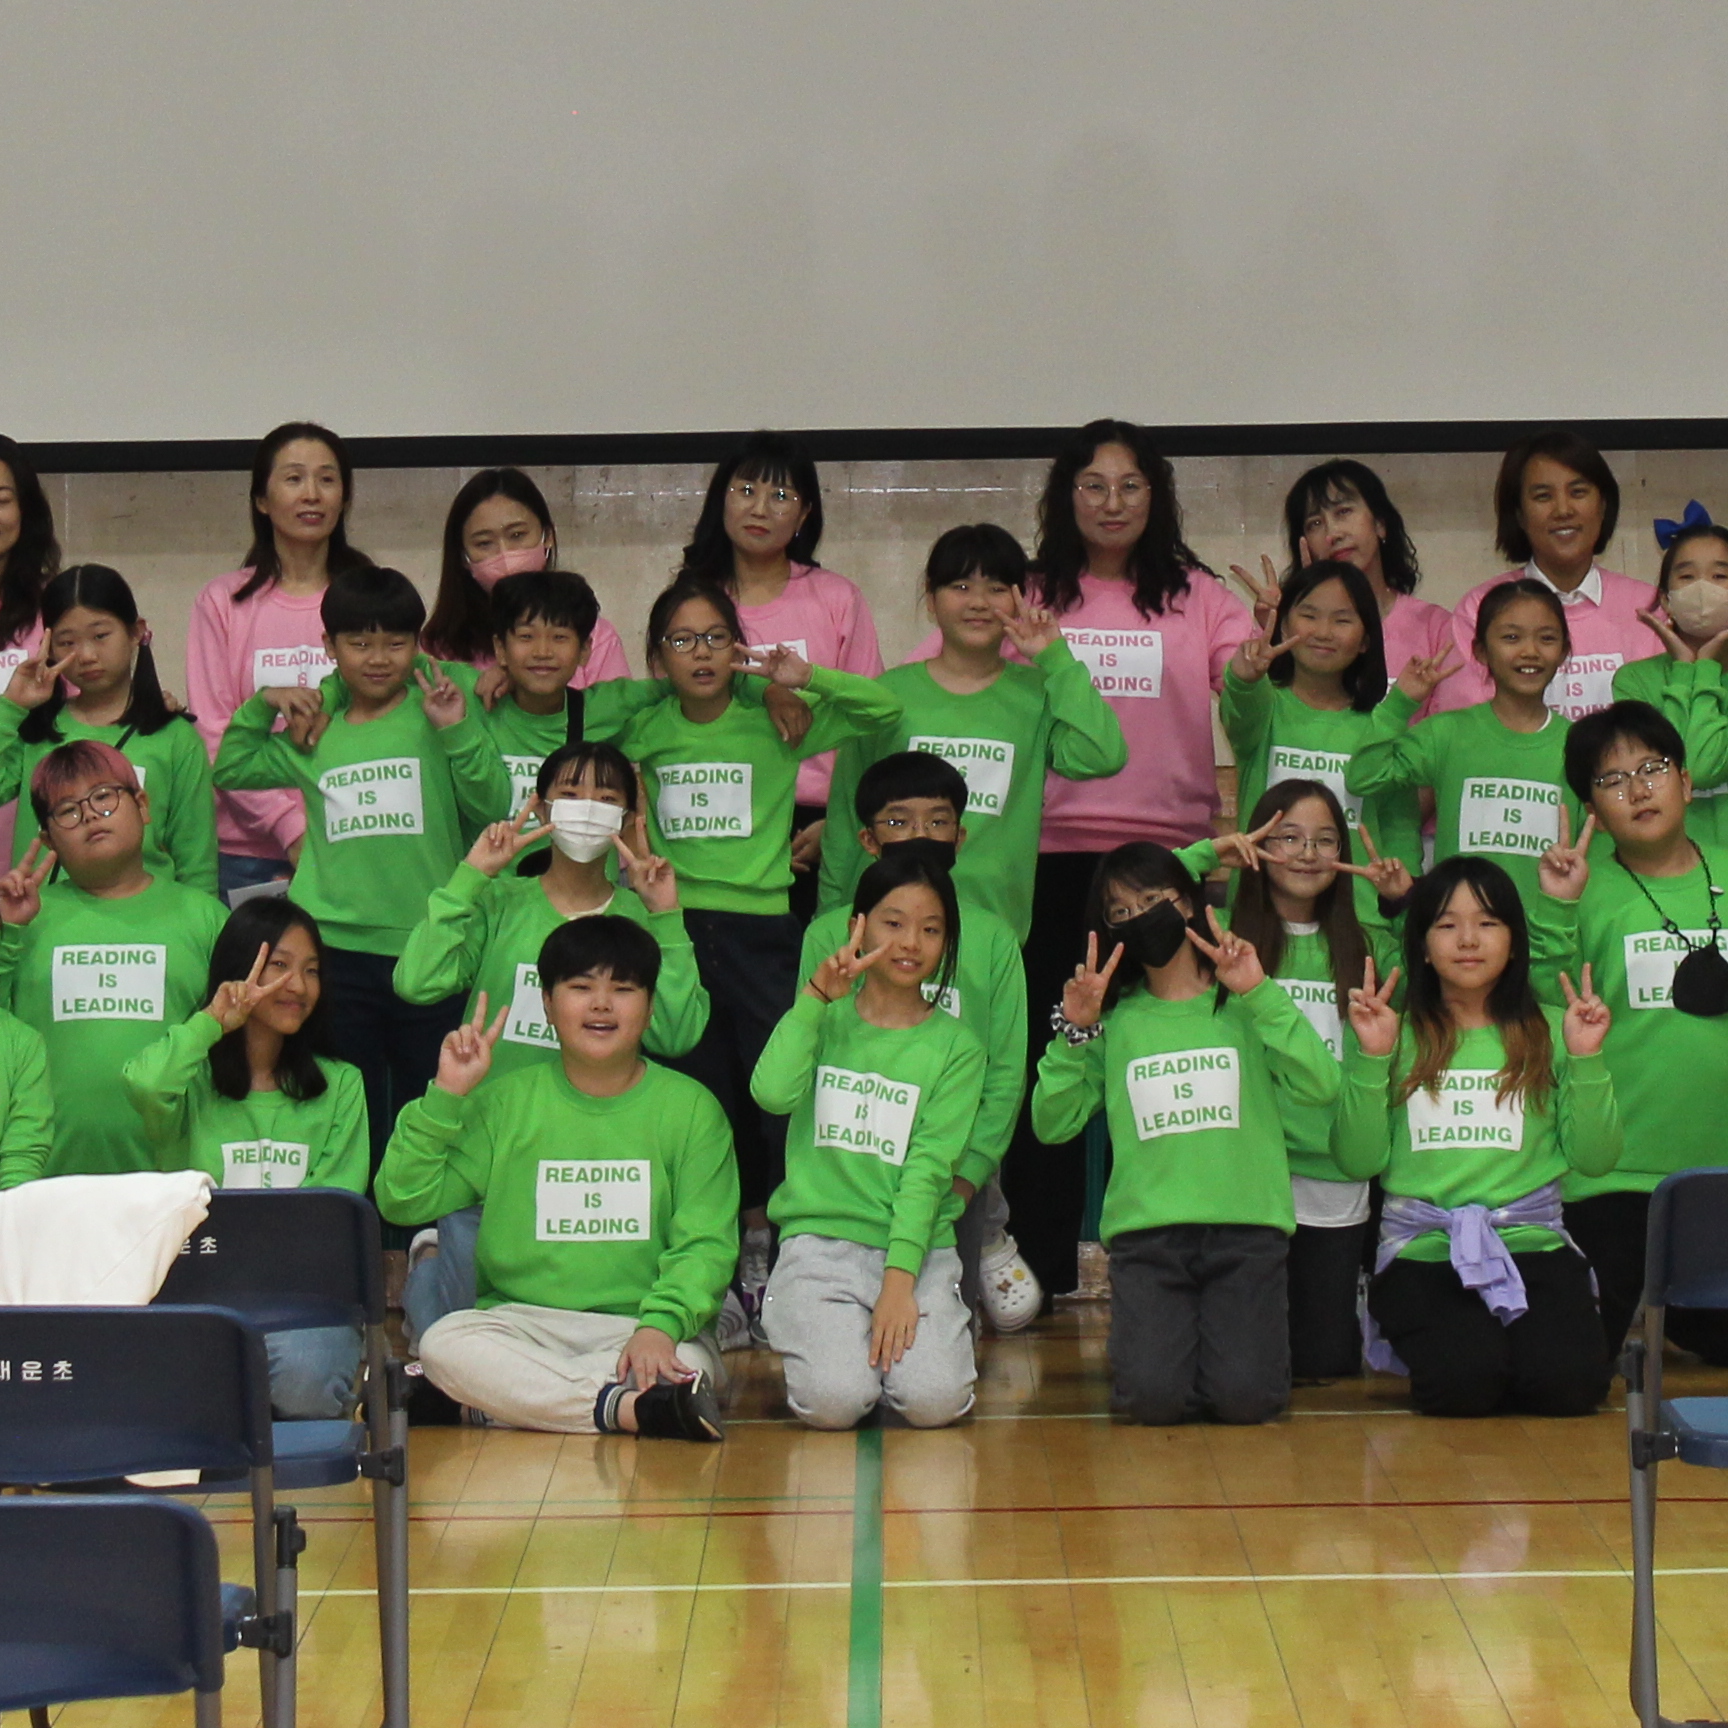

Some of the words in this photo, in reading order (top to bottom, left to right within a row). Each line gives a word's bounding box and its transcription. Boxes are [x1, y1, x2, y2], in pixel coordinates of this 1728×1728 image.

[1099, 653, 1118, 667] IS
[1092, 676, 1153, 692] ADING
[1566, 682, 1584, 697] IS
[1275, 752, 1347, 774] READIN
[326, 764, 413, 789] READING
[662, 769, 744, 786] READING
[358, 790, 378, 806] IS
[690, 793, 709, 808] IS
[1470, 783, 1562, 807] READING
[331, 813, 416, 835] LEADING
[1503, 808, 1523, 824] IS
[664, 817, 743, 834] LEADING
[62, 950, 157, 966] READING
[98, 973, 118, 988] IS
[62, 998, 155, 1014] LEADING
[1134, 1054, 1231, 1081] READING
[823, 1072, 909, 1105] READING
[1174, 1082, 1194, 1099] IS
[855, 1104, 869, 1121] IS
[1454, 1100, 1474, 1116] IS
[1143, 1105, 1233, 1132] LEADING
[1419, 1126, 1513, 1143] LEADING
[545, 1167, 641, 1183] READING
[584, 1193, 603, 1209] IS
[546, 1218, 640, 1235] LEADING
